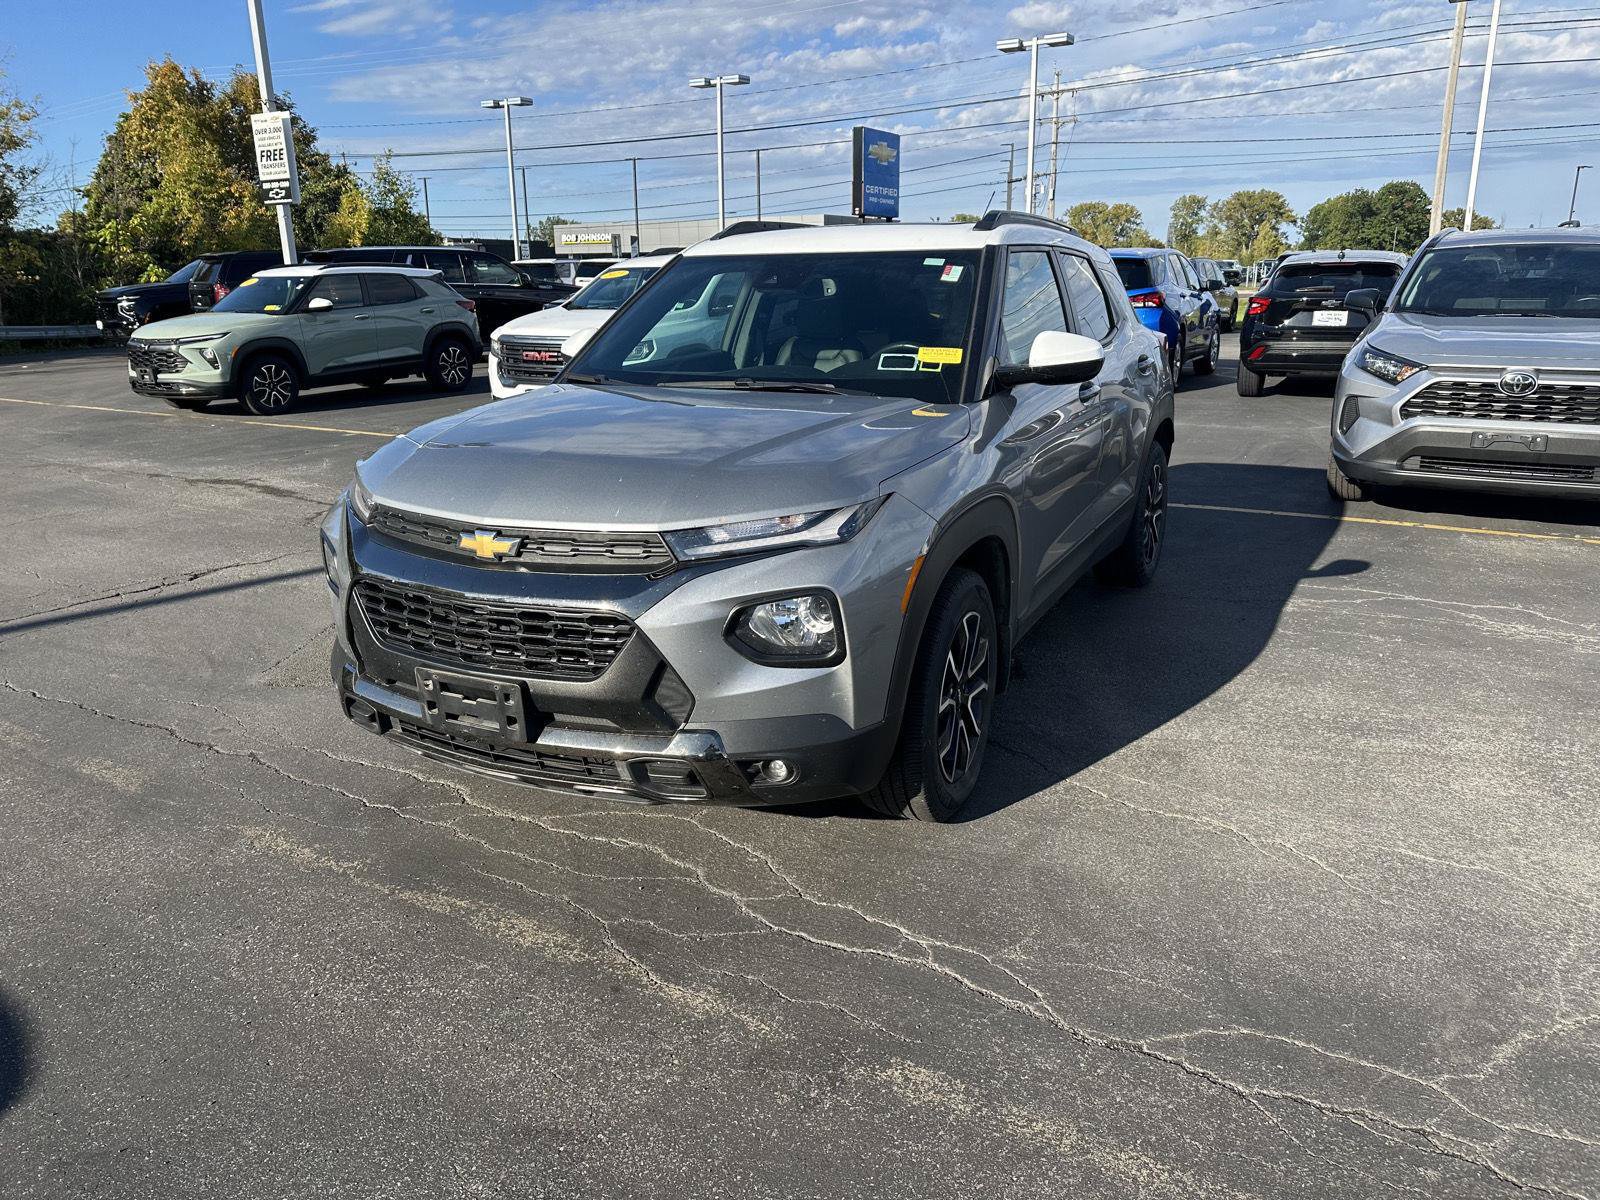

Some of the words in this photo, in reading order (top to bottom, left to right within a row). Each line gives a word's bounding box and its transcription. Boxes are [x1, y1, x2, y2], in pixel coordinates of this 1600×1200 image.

[260, 148, 284, 162] FREE
[866, 185, 897, 196] CERTIFIED
[561, 233, 576, 242] BOB
[577, 232, 612, 243] JOHNSON
[523, 351, 557, 361] GMC
